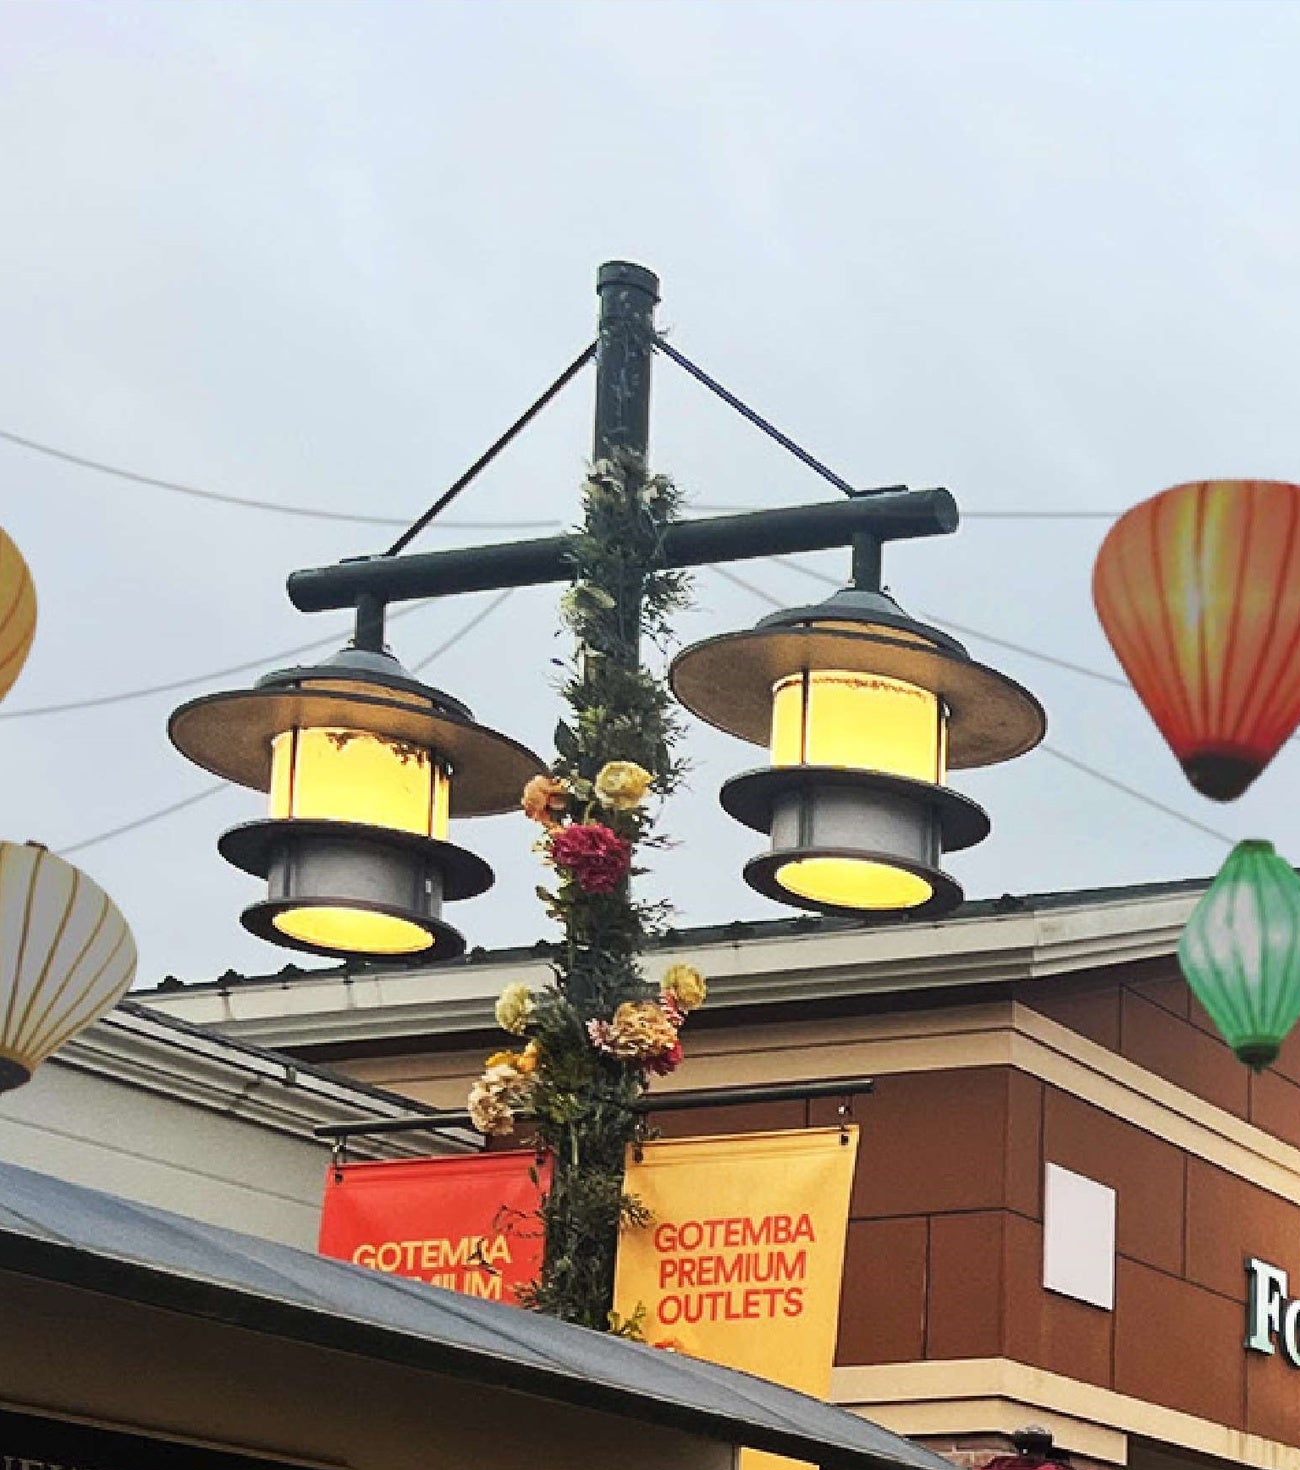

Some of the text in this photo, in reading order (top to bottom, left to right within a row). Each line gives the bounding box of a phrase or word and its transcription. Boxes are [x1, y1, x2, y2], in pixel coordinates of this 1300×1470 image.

[655, 1213, 816, 1253] GOTEMBA
[658, 1249, 807, 1290] PREMIUM
[656, 1286, 804, 1326] OUTLETS
